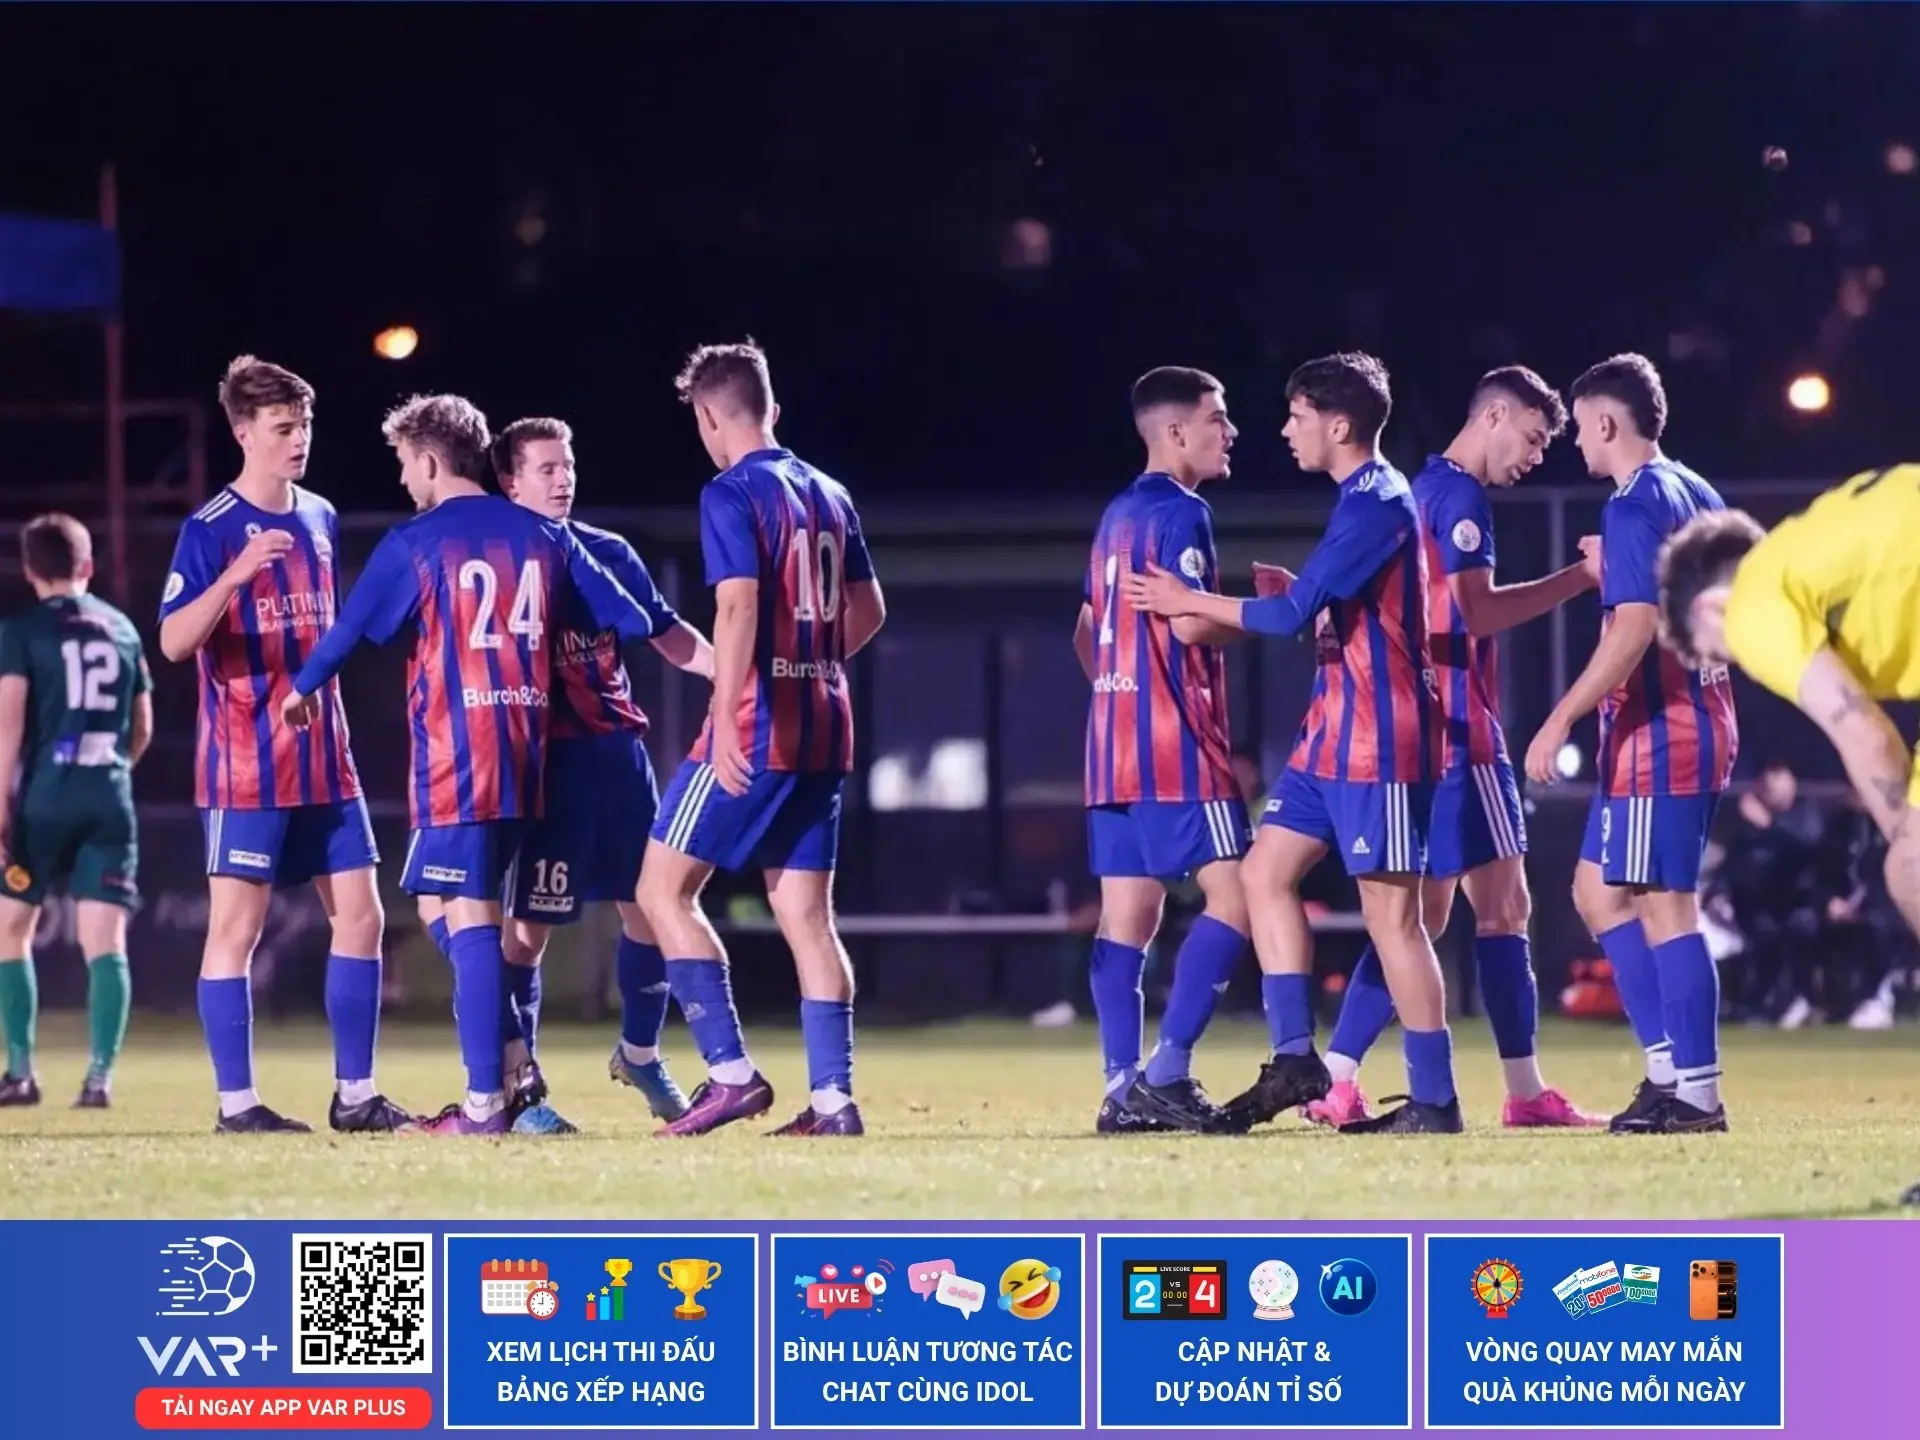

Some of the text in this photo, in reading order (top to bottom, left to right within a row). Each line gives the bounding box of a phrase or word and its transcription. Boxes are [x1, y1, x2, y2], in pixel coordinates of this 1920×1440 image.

[459, 559, 543, 651] 24
[789, 529, 841, 622] 10
[62, 639, 120, 711] 12
[533, 859, 568, 895] 16
